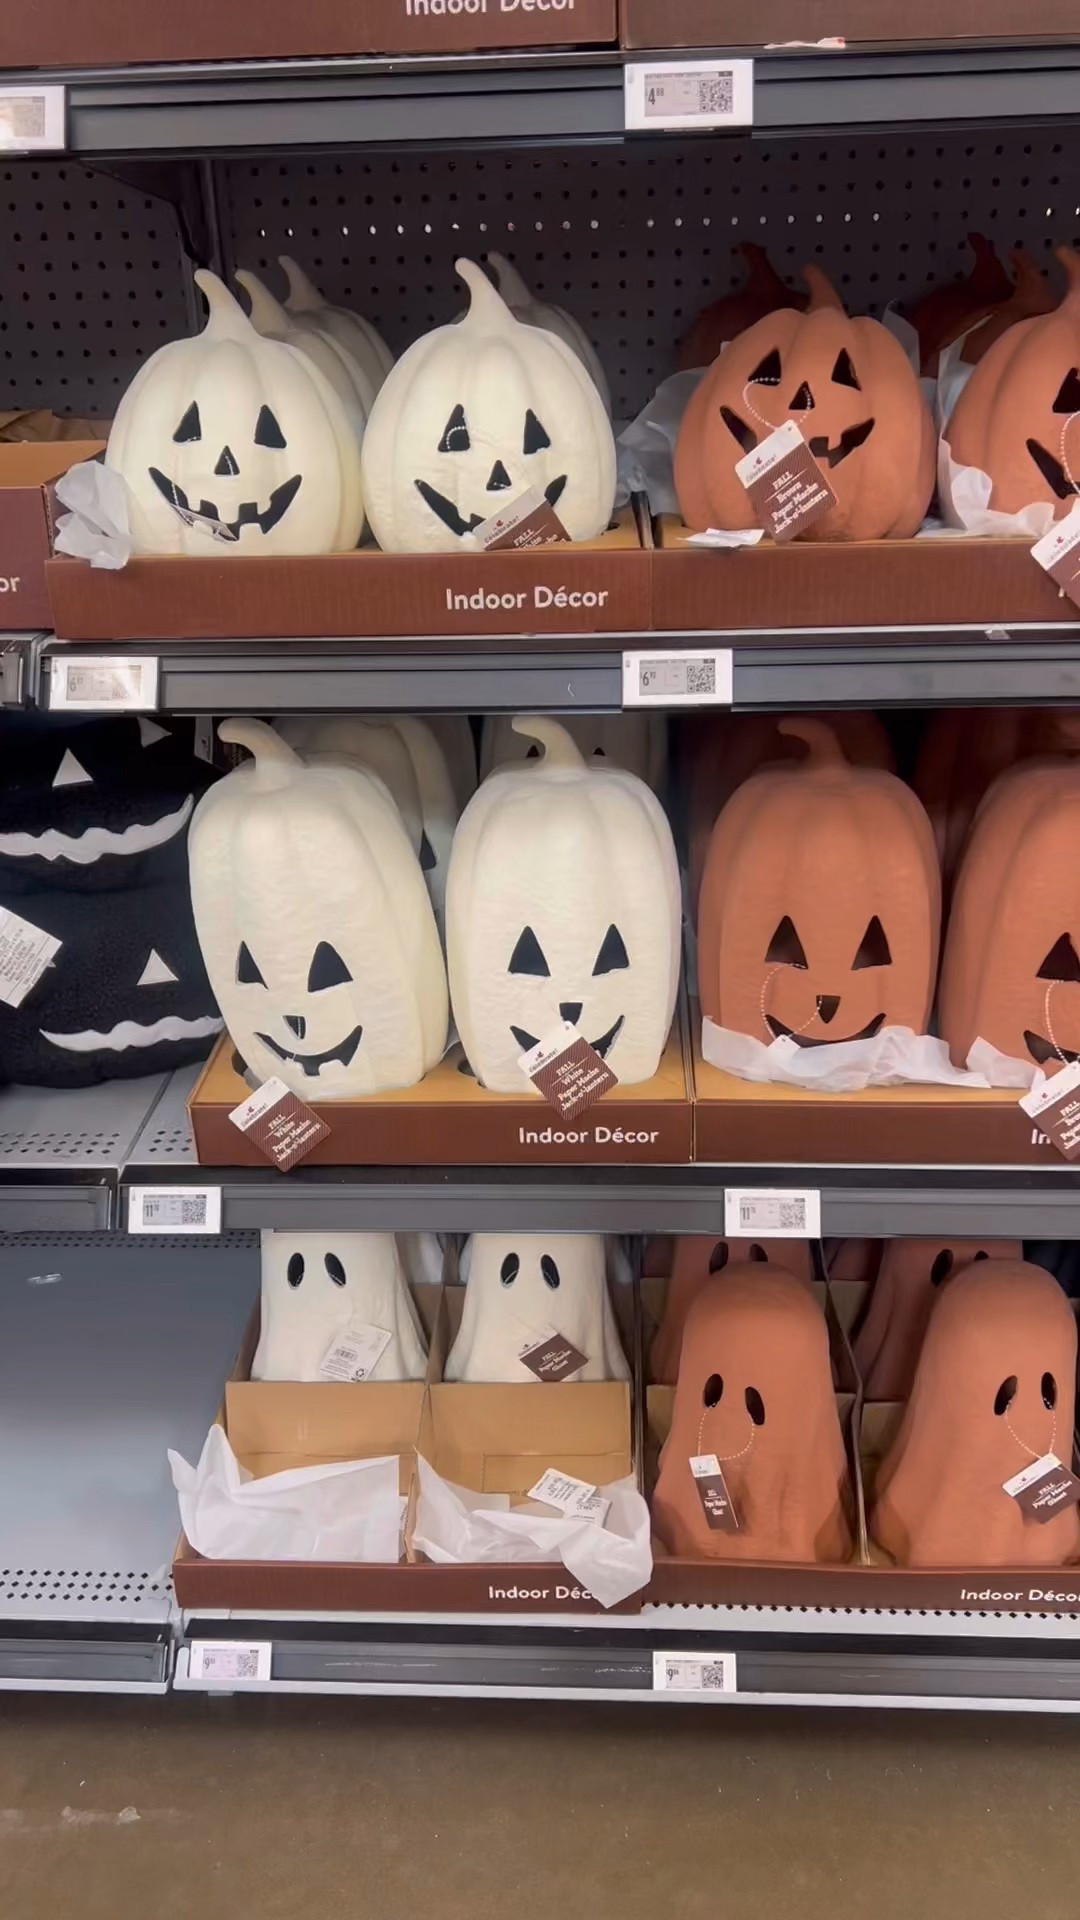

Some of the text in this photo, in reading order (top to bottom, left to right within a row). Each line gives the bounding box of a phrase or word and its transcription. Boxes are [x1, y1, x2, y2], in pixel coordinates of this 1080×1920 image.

[773, 471, 793, 489] FALL
[771, 501, 793, 521] Paper
[513, 529, 534, 546] FALL
[446, 585, 609, 610] Indoor Décor
[556, 1061, 575, 1076] FALL
[561, 1068, 584, 1085] White
[557, 1084, 577, 1101] Paper
[519, 1126, 659, 1144] Indoor Décor
[488, 1585, 593, 1599] Indoor Déc
[960, 1589, 1080, 1602] Indoor Déco
